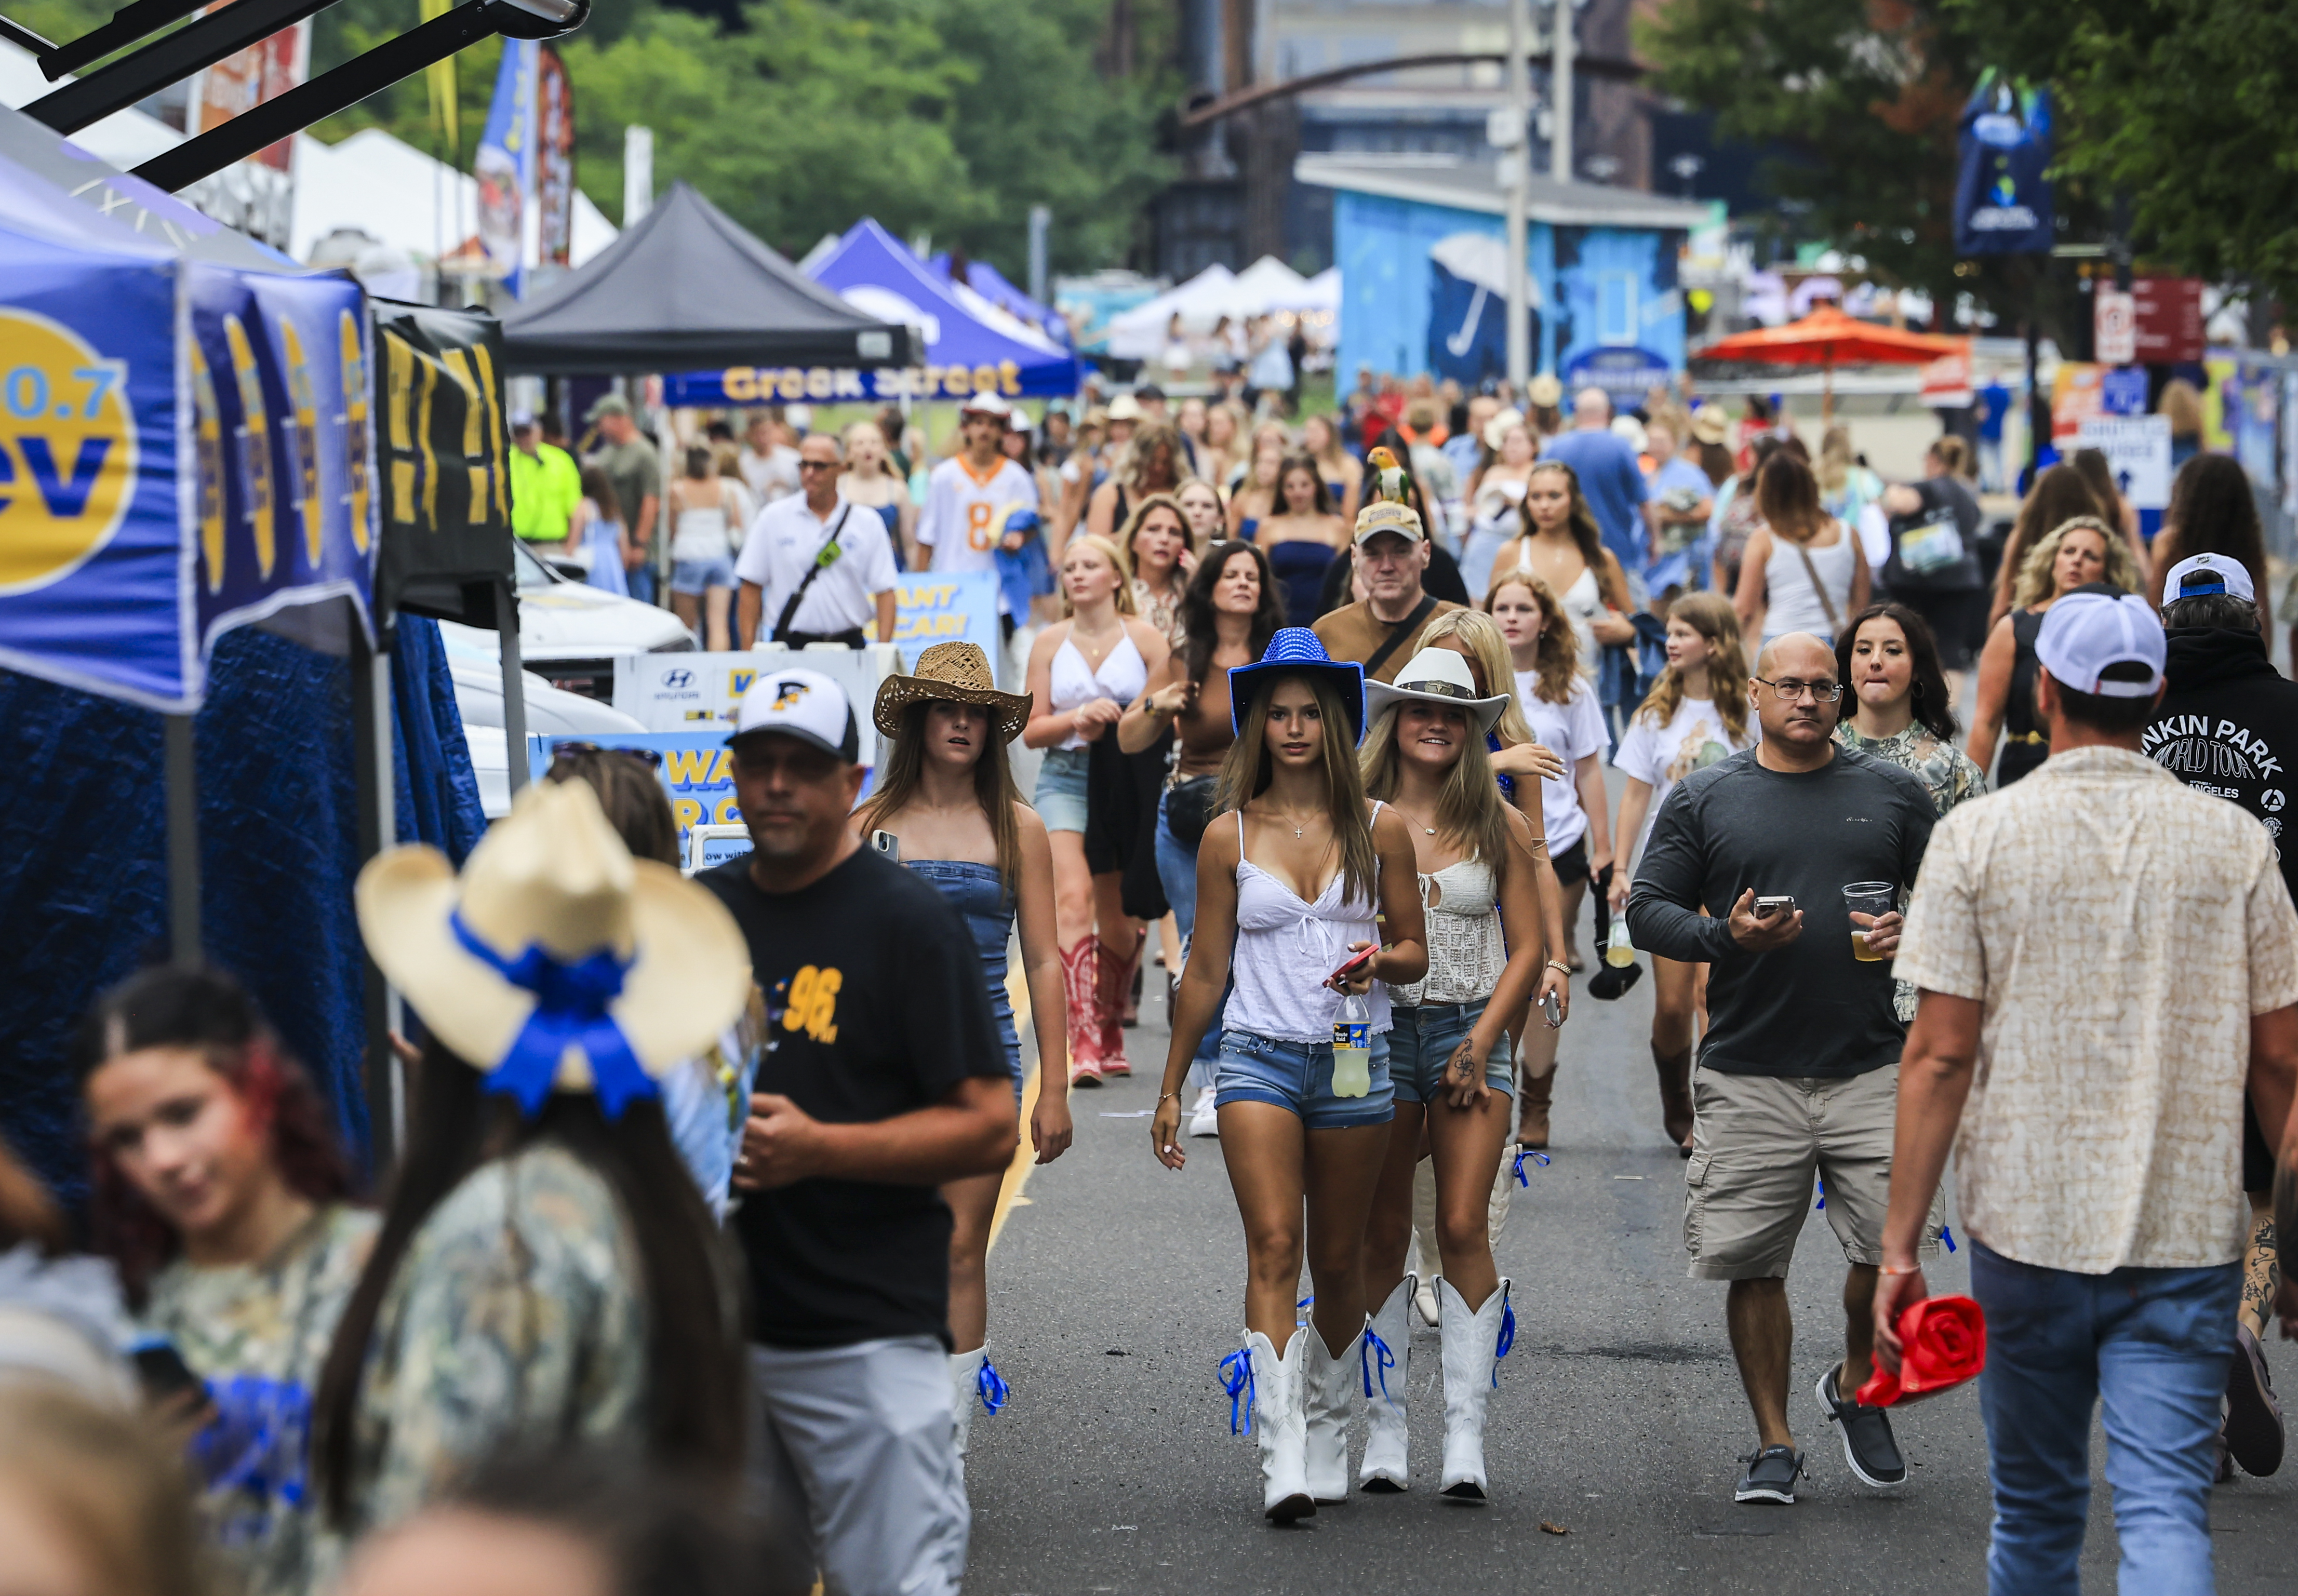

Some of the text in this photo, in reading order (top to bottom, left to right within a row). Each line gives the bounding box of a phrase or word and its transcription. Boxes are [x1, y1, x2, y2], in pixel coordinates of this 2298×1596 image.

[5, 365, 118, 419] 0.7
[722, 366, 865, 401] Greek
[2141, 715, 2283, 781] NKIN PARK
[2209, 740, 2256, 780] TOUR
[2188, 783, 2239, 799] ANGELES
[705, 851, 723, 860] ow
